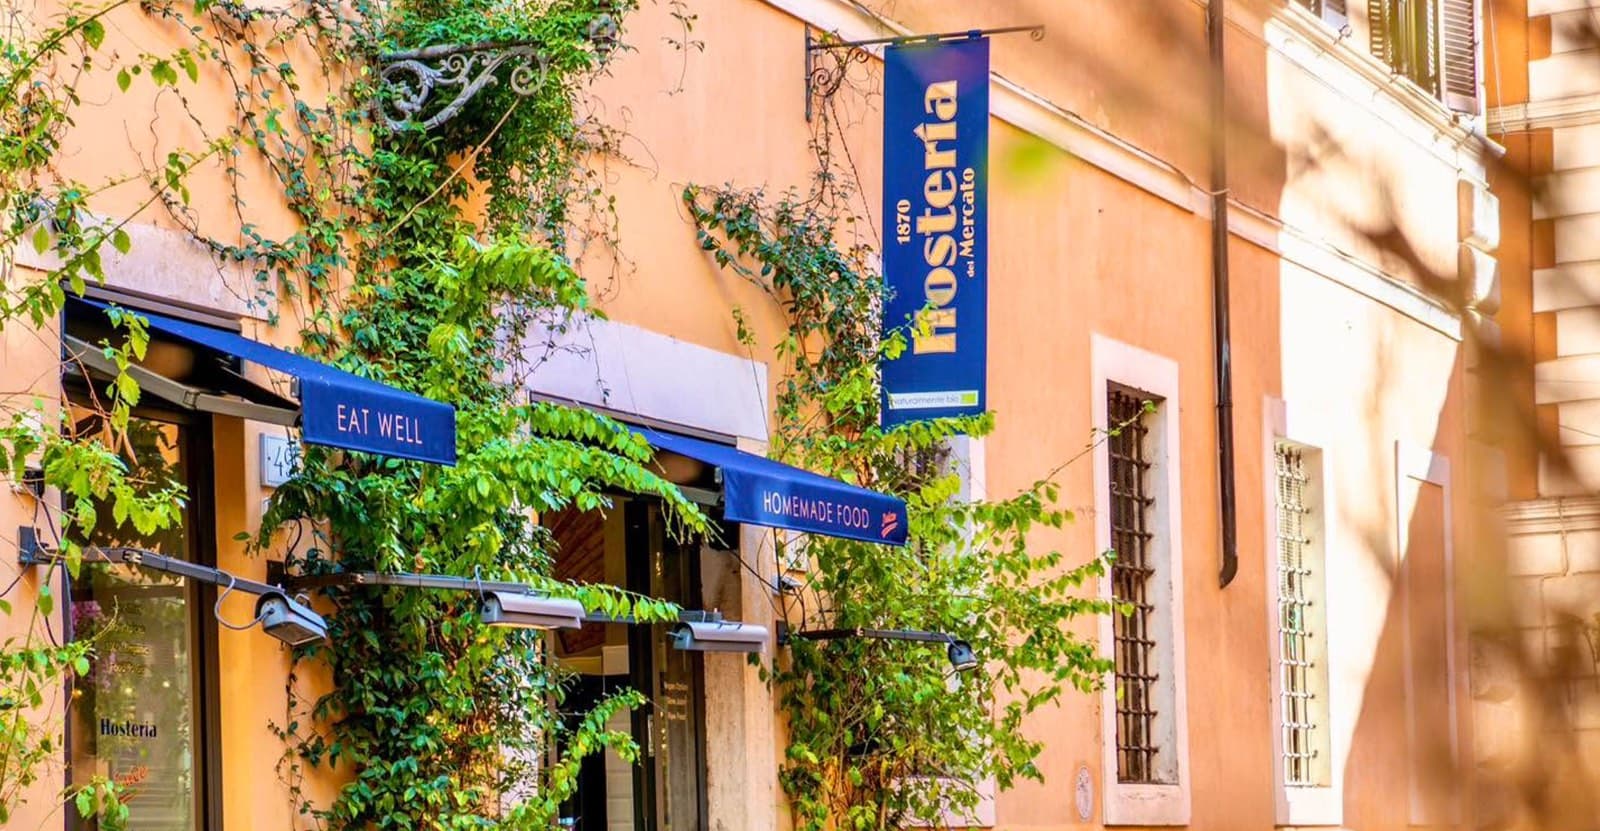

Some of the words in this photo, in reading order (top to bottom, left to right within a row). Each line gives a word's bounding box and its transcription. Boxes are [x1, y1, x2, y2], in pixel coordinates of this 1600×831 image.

[896, 199, 911, 245] 1870
[959, 167, 976, 257] Mercato
[966, 261, 976, 279] del
[337, 403, 370, 436] EAT
[377, 410, 423, 445] WELL
[762, 490, 833, 524] HOMEMADE
[836, 503, 870, 529] FOOD
[100, 717, 157, 738] Hosteria
